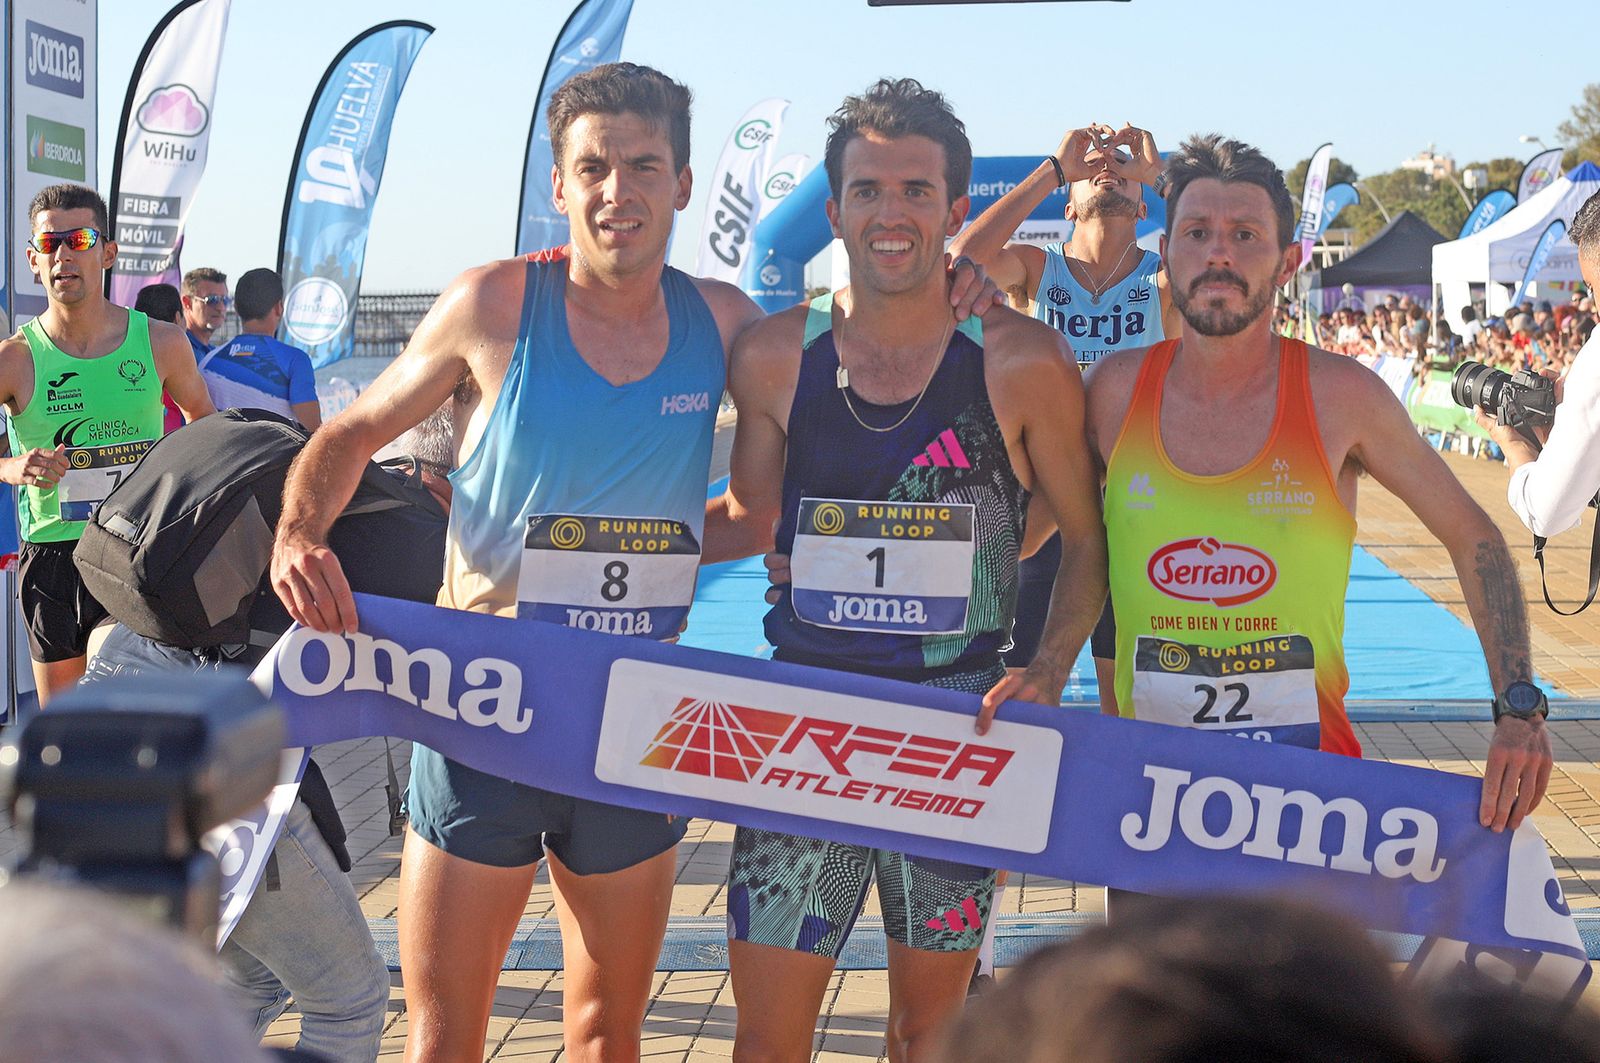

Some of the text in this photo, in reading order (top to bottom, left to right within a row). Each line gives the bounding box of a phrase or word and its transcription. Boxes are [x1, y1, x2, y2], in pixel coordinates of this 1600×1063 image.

[29, 32, 81, 82] Joma
[327, 62, 379, 153] HUELVA
[743, 127, 773, 144] CSIF
[43, 142, 83, 165] IBERDROLA
[144, 140, 197, 162] WiHu
[968, 182, 1016, 196] uerto
[123, 198, 169, 215] FIBRA
[709, 172, 753, 267] CSIF
[120, 226, 166, 244] MÓVIL
[1047, 304, 1146, 346] nerja
[53, 402, 84, 412] UCLM
[661, 391, 709, 416] HOKA
[88, 420, 127, 431] CLÍNICA
[89, 427, 140, 441] MENORCA
[99, 442, 149, 457] RUNNING
[1248, 491, 1316, 505] SERRANO
[857, 505, 951, 521] RUNNING
[599, 521, 682, 535] RUNNING
[881, 525, 934, 537] LOOP
[620, 540, 670, 552] LOOP
[866, 547, 886, 588] 1
[1158, 555, 1265, 586] Serrano
[600, 560, 629, 602] 8
[828, 595, 927, 624] Joma
[563, 608, 652, 635] Joma
[1151, 615, 1278, 632] COME BIEN Y CORRE
[1198, 639, 1291, 657] RUNNING
[1221, 658, 1276, 674] LOOP
[278, 626, 534, 735] oma
[1192, 682, 1253, 724] 22
[778, 715, 1016, 787] RFEA
[760, 768, 986, 820] ATLETISMO
[1119, 764, 1447, 883] Joma
